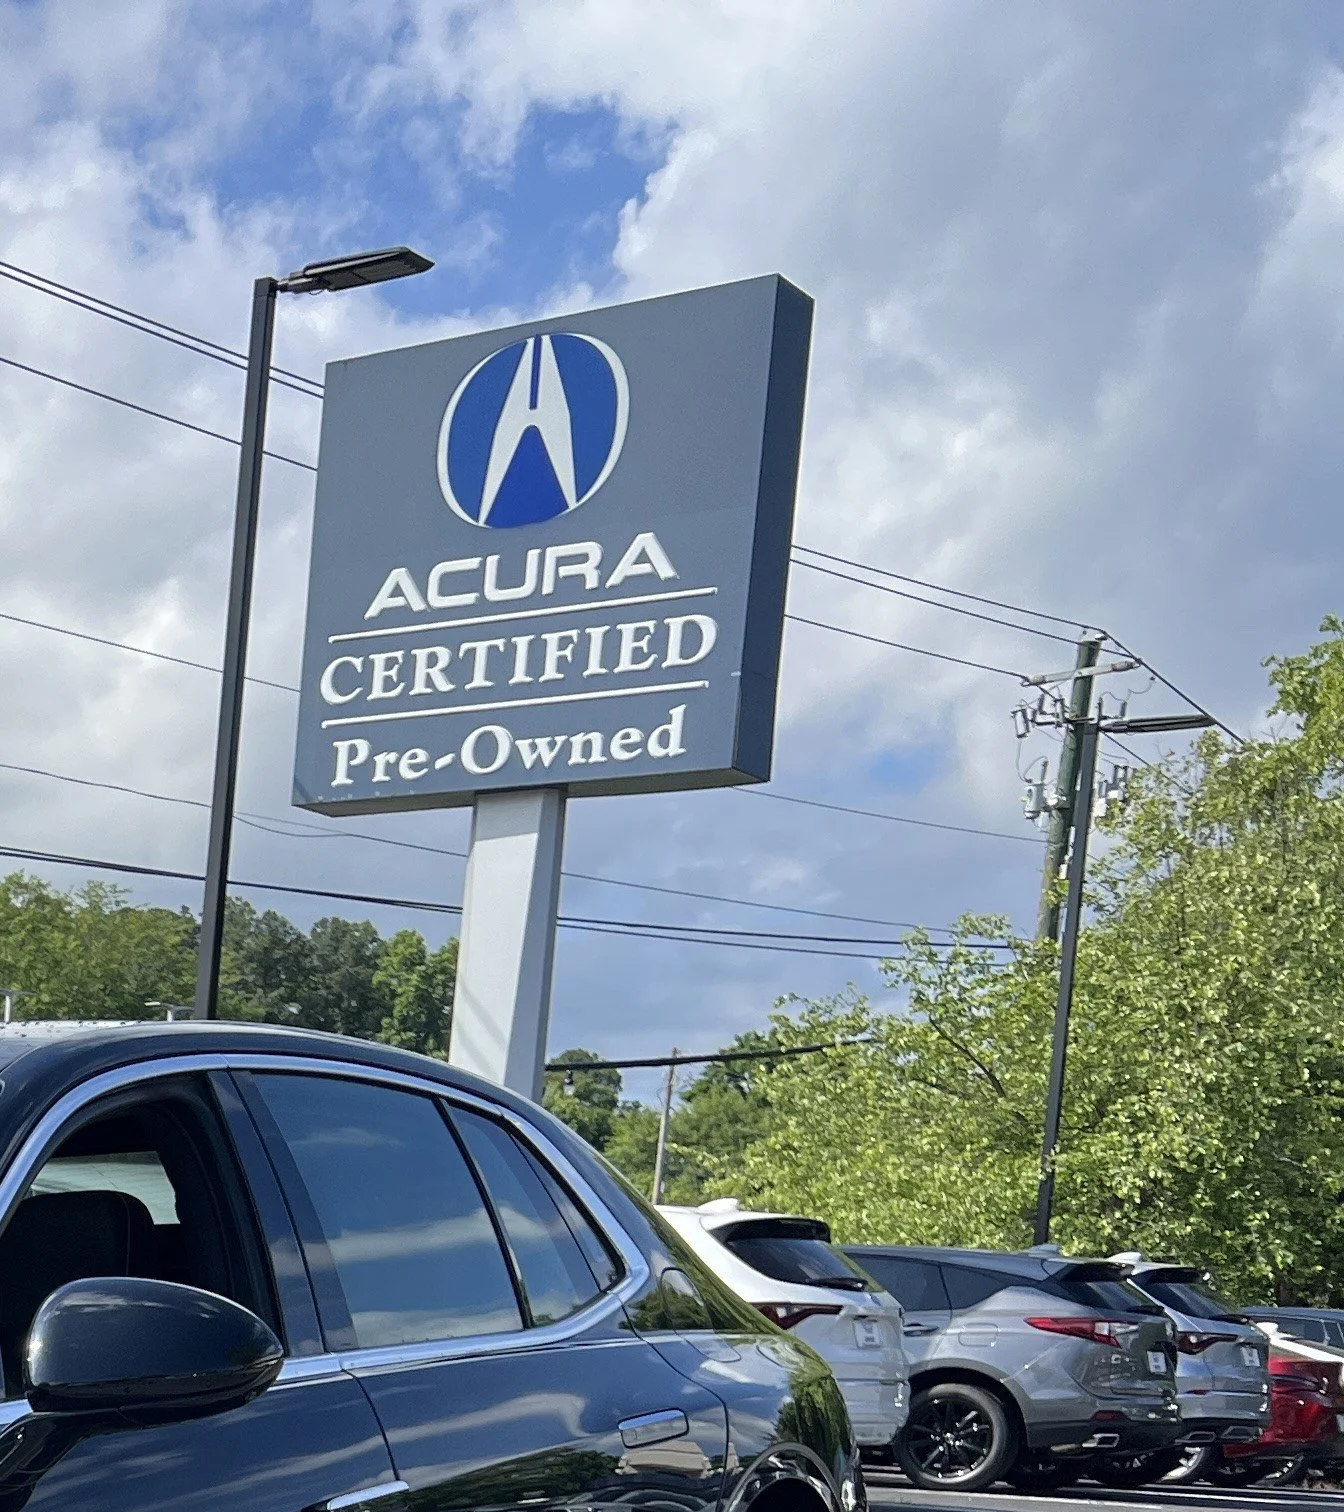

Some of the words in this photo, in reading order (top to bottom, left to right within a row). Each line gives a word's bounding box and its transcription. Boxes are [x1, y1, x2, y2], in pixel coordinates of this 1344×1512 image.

[364, 532, 679, 620] ACURA
[320, 613, 719, 706] CERTIFIED
[331, 704, 687, 787] Pre-Owned
